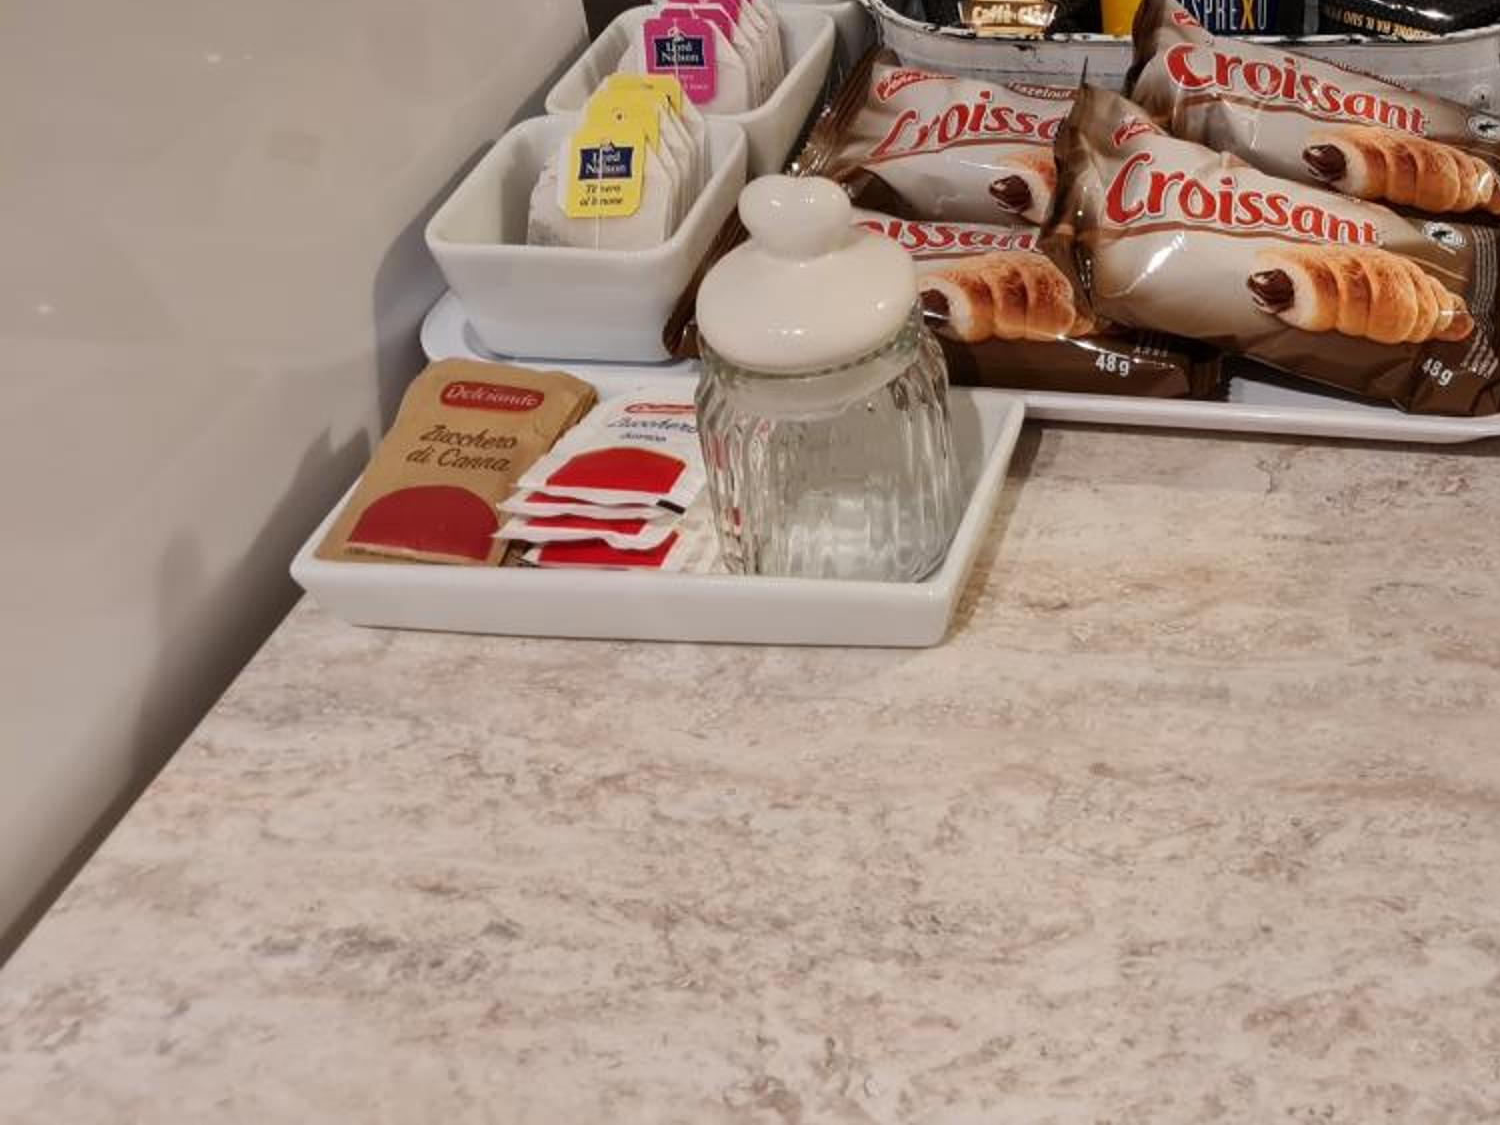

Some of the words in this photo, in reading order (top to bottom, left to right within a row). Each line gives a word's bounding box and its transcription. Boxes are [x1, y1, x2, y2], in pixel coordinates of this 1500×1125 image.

[1166, 44, 1430, 136] Croissant
[1105, 152, 1377, 245] Croissant
[405, 445, 434, 464] di
[437, 448, 513, 472] Canna
[419, 425, 518, 449] Zucchero
